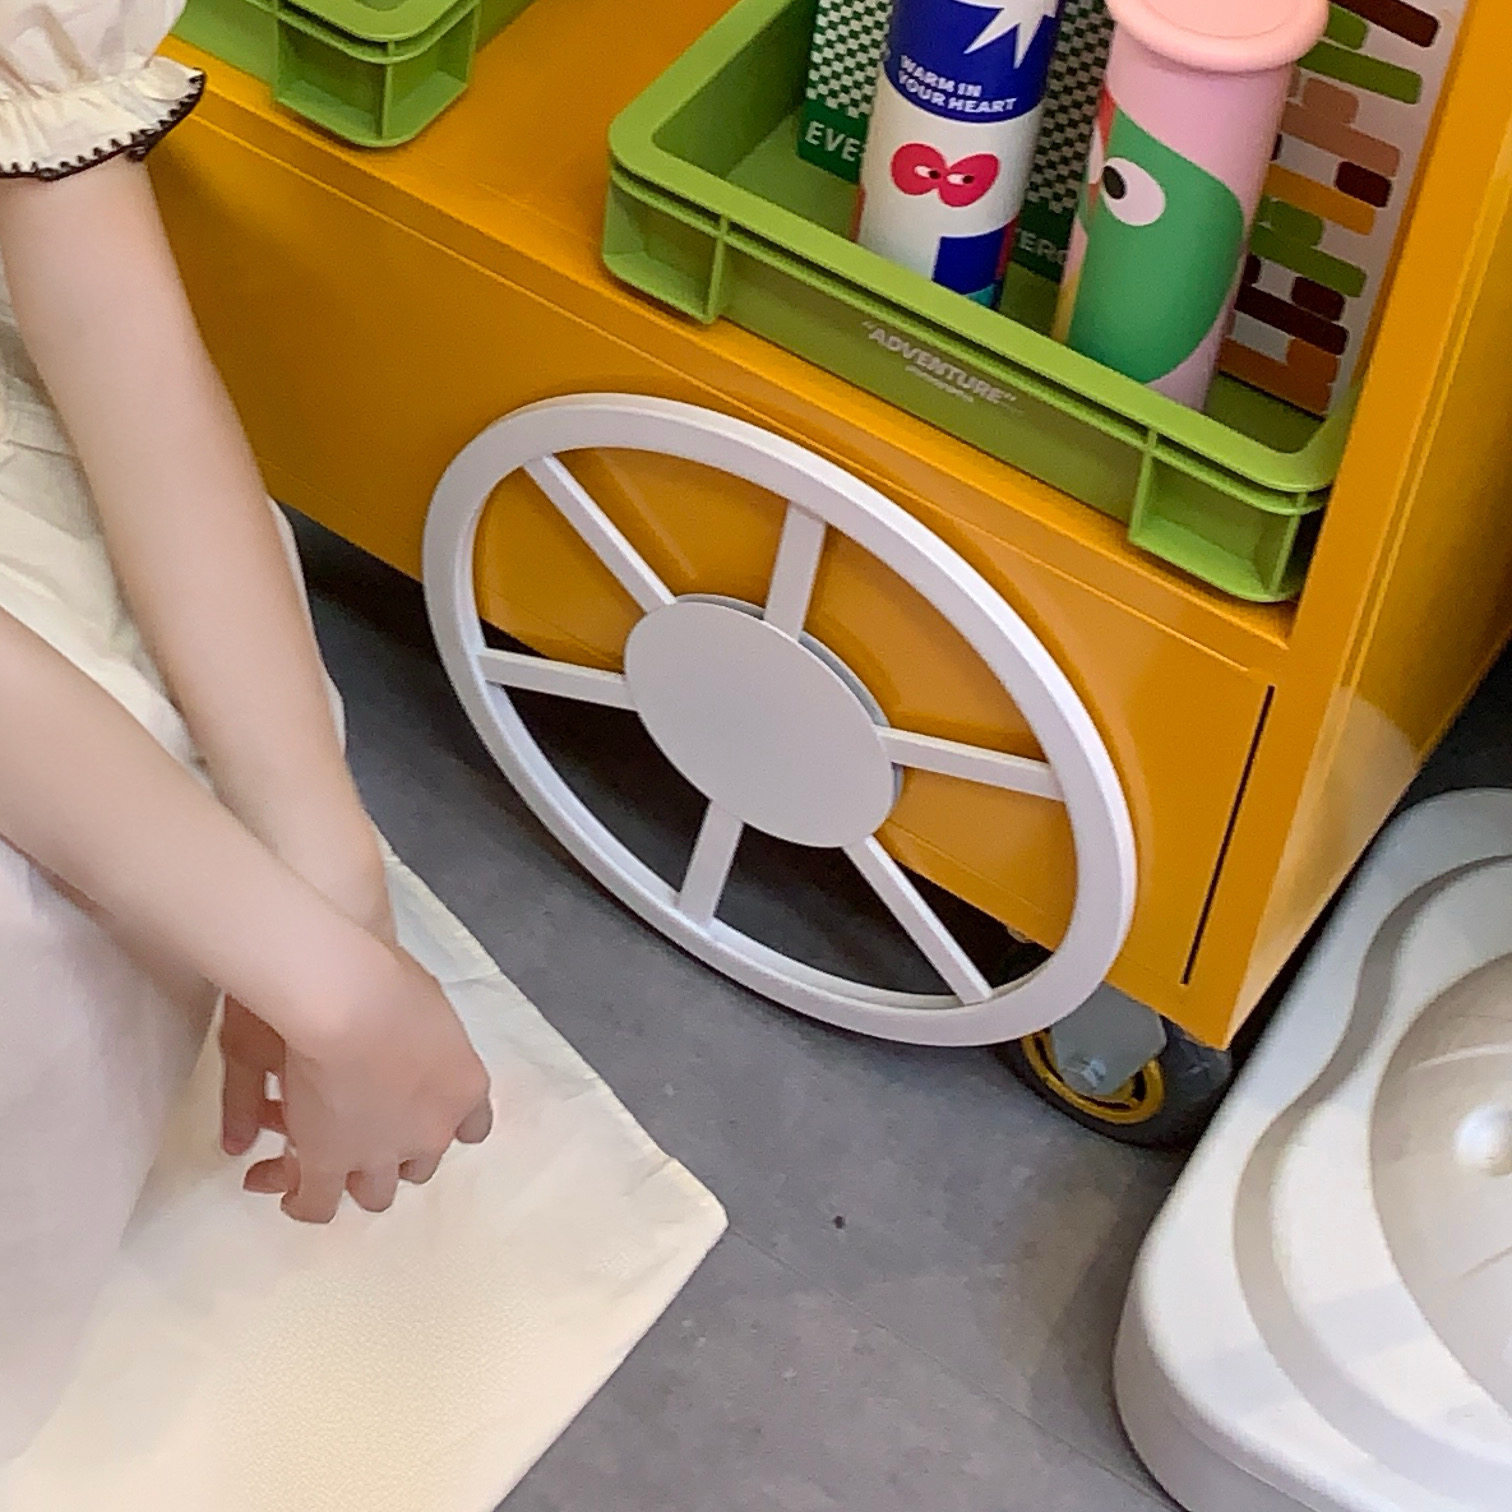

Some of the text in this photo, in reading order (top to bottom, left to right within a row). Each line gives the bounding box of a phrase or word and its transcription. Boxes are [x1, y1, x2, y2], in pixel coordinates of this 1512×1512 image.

[898, 70, 1017, 113] YOUR HEART
[900, 54, 982, 98] WARM IN
[804, 120, 867, 162] EVE
